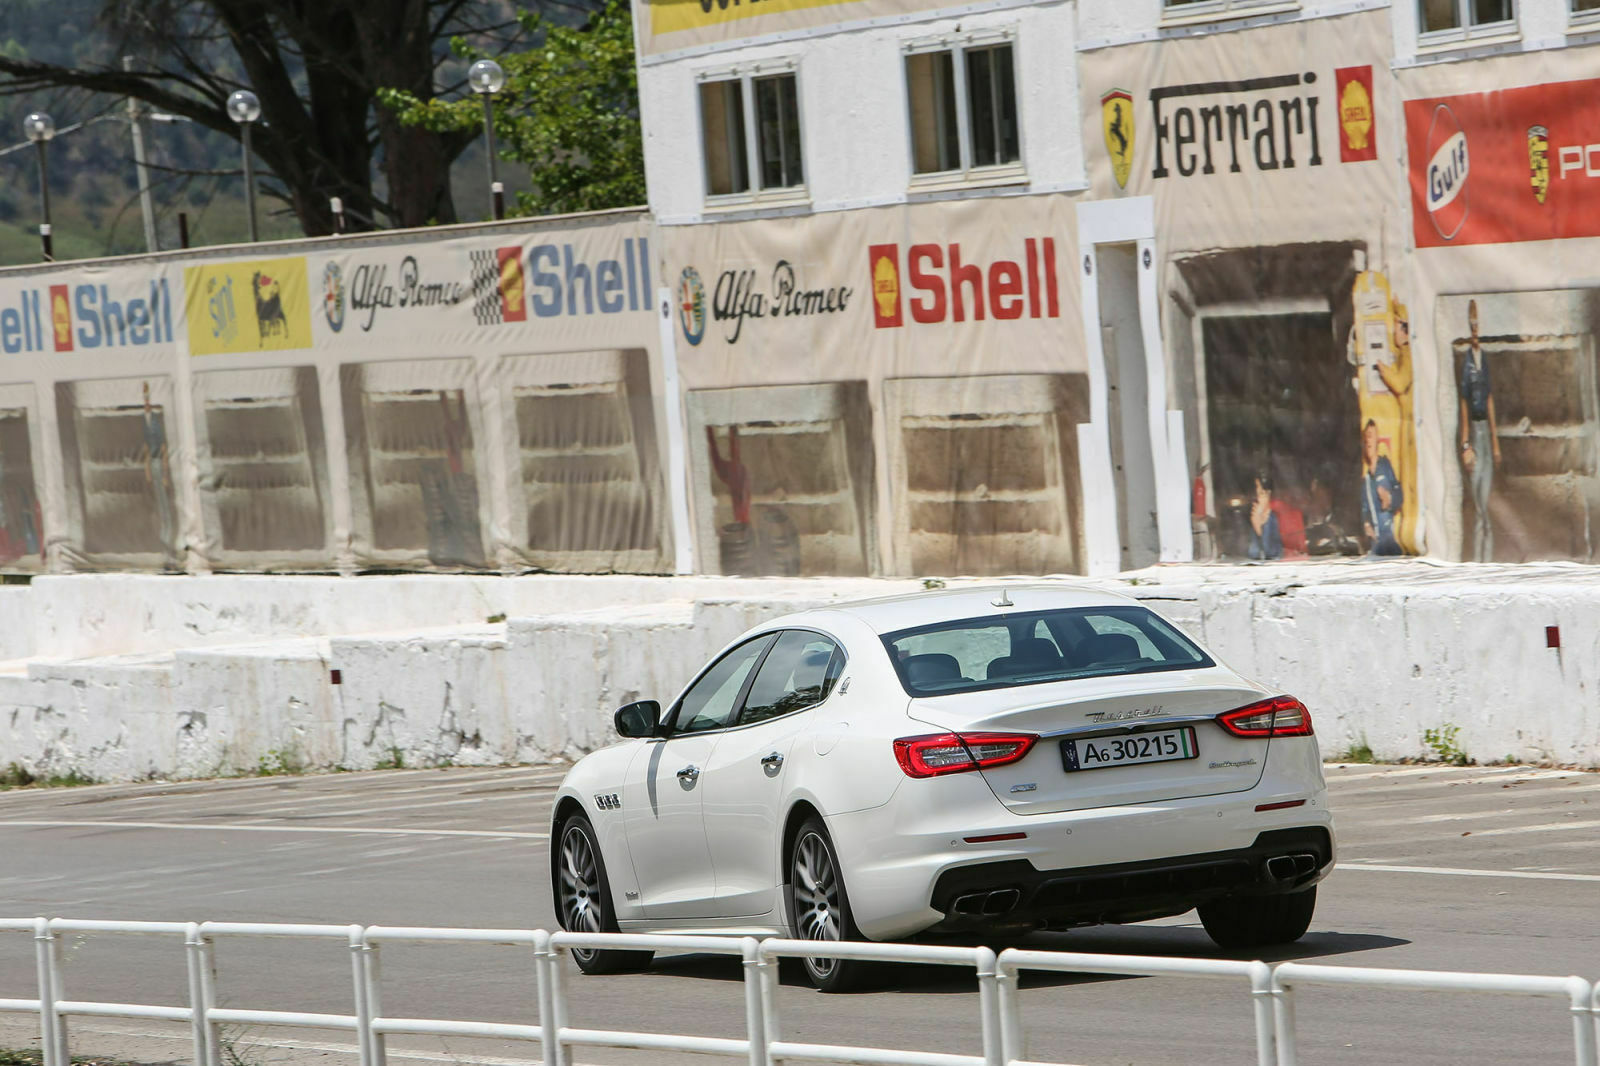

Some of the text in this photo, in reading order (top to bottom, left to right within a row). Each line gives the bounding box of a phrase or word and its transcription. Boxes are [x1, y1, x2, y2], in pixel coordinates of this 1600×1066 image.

[1149, 71, 1322, 178] Ferrari
[1430, 139, 1465, 203] Gulf
[75, 278, 173, 348] Shell
[351, 264, 395, 332] Alfa
[529, 237, 653, 318] Shell
[712, 260, 853, 345] Alfa Romeo
[907, 236, 1060, 324] Shell
